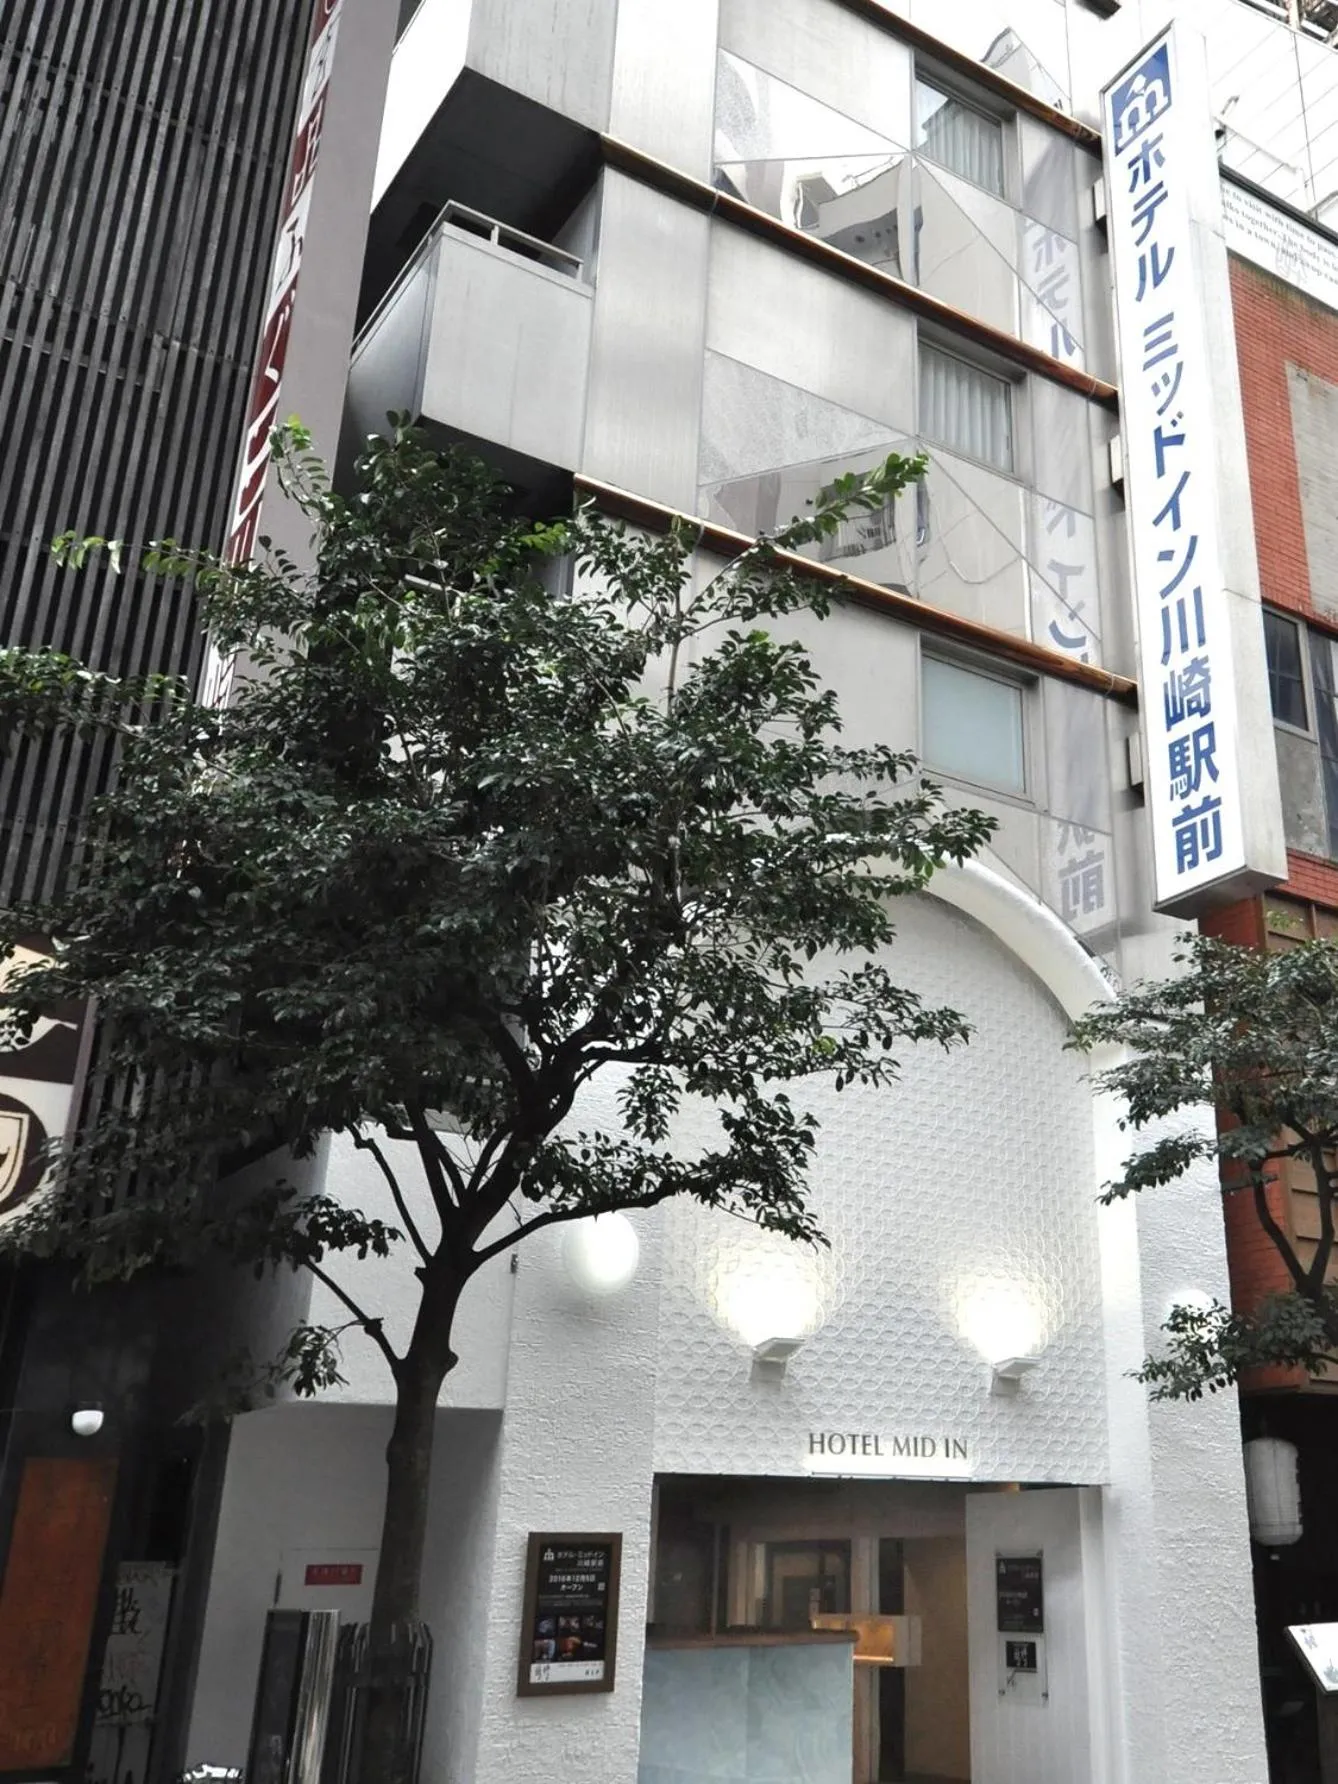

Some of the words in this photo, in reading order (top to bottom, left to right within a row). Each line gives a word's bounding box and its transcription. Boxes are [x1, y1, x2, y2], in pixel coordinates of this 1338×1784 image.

[1128, 132, 1175, 302] ホテル
[809, 1433, 884, 1456] HOTEL
[893, 1436, 936, 1458] MID
[945, 1438, 968, 1459] IN
